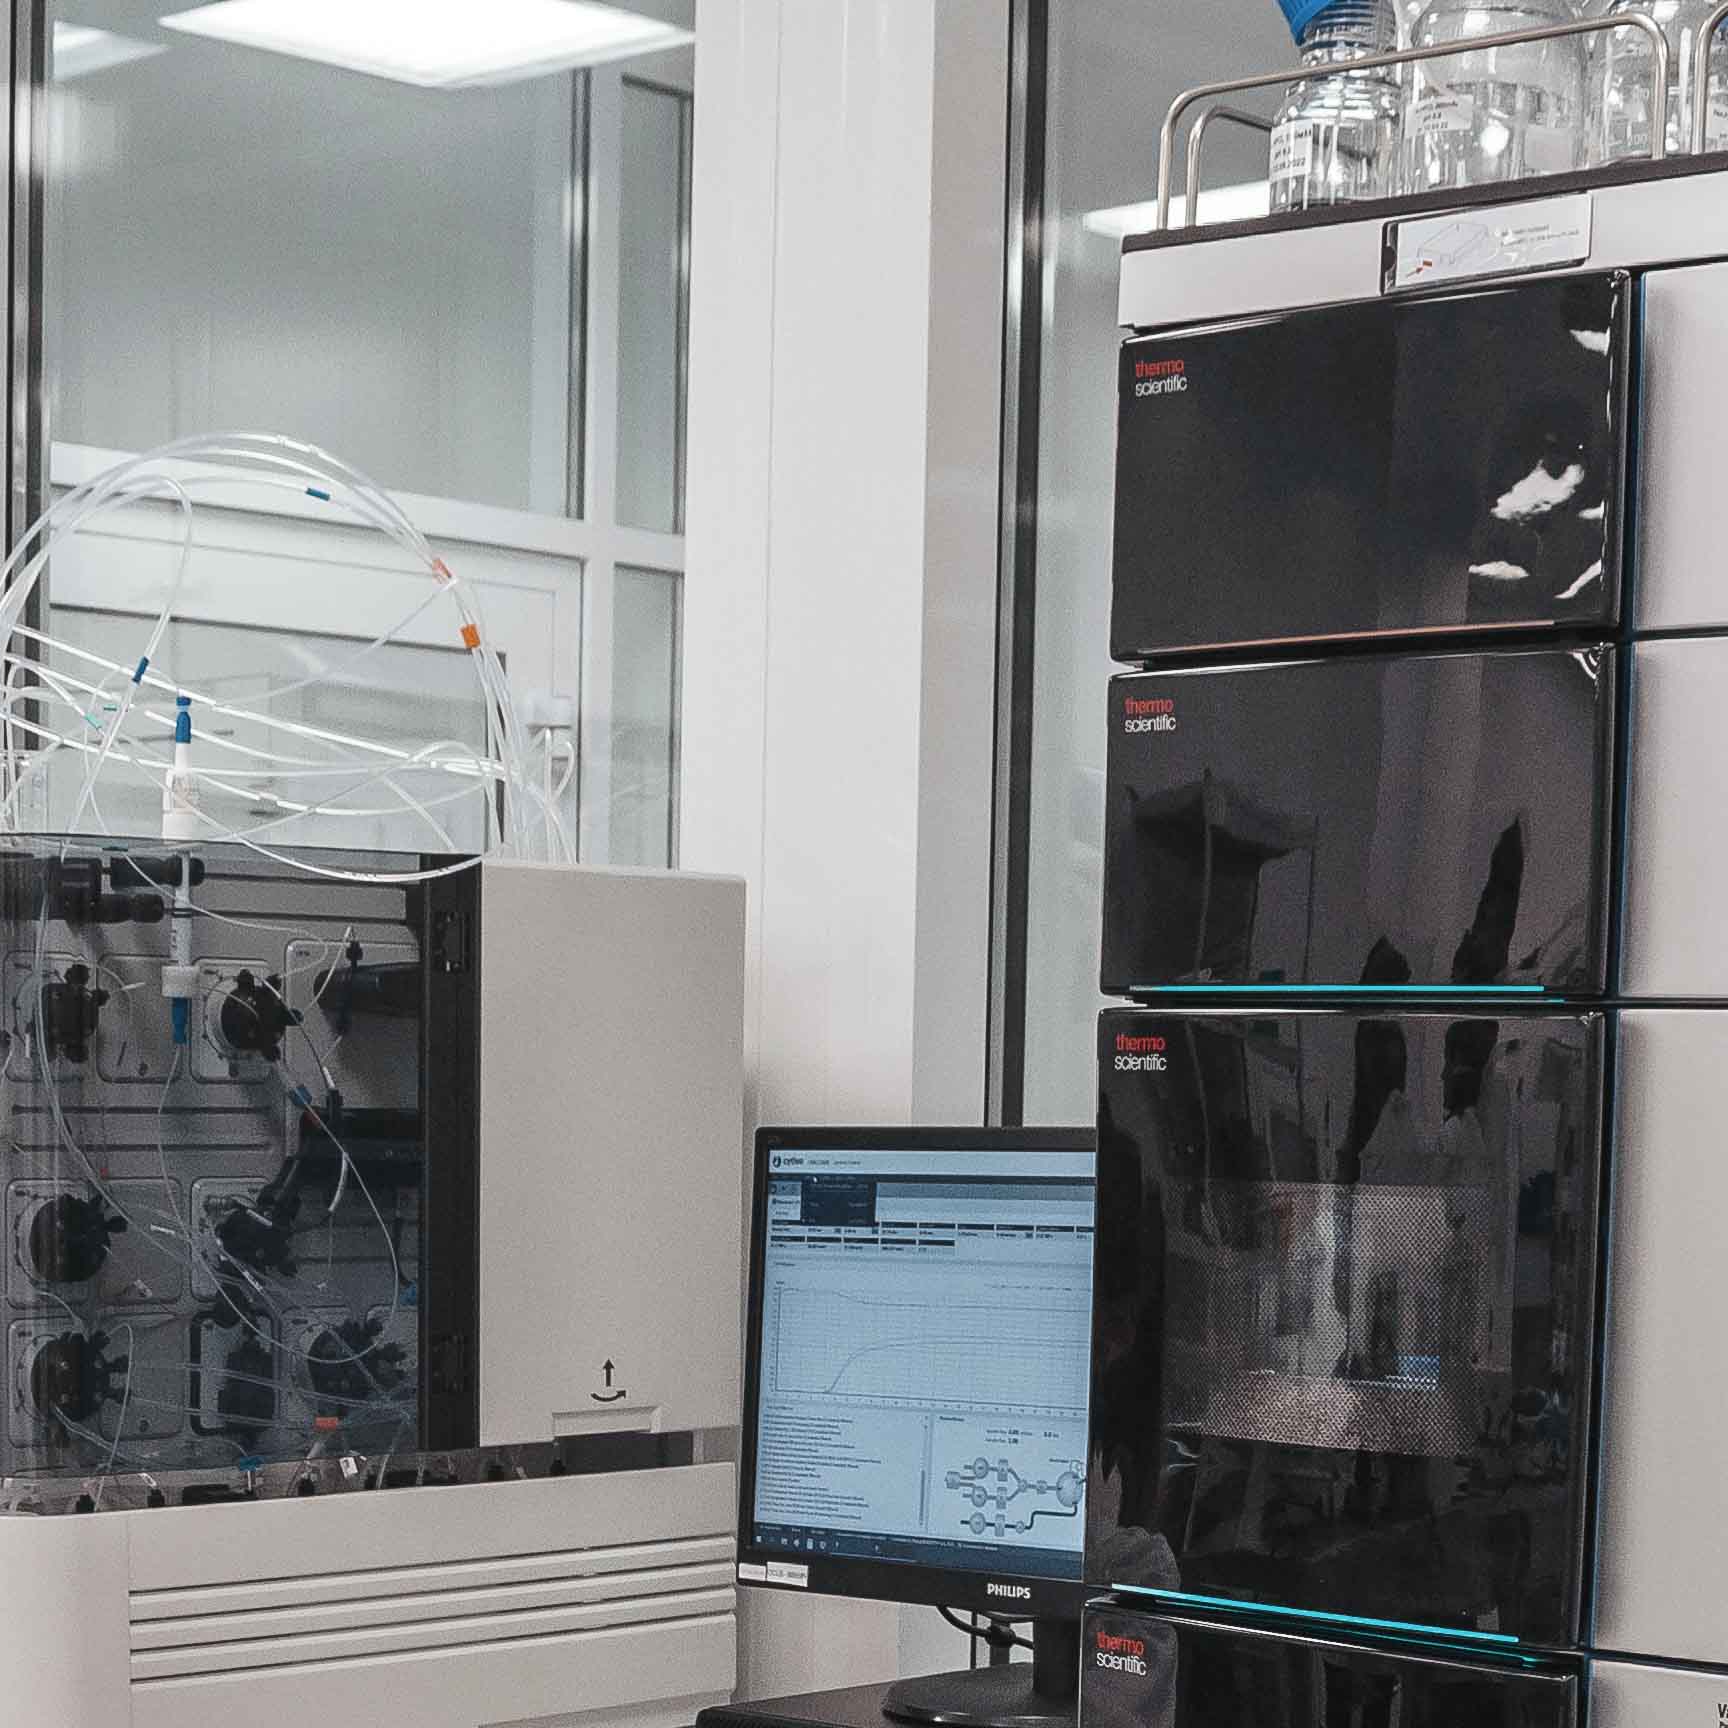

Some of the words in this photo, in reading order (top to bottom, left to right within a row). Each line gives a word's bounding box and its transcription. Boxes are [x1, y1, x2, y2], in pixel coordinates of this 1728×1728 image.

[1136, 360, 1184, 378] thermo
[1136, 375, 1188, 397] scientific
[1124, 697, 1174, 715] thermo
[1124, 714, 1177, 733] scientific
[1115, 1033, 1166, 1052] thermo
[1114, 1053, 1167, 1071] scientific
[987, 1583, 1032, 1600] PHILIPS
[1096, 1631, 1144, 1656] thermo
[1096, 1652, 1147, 1676] scientific
